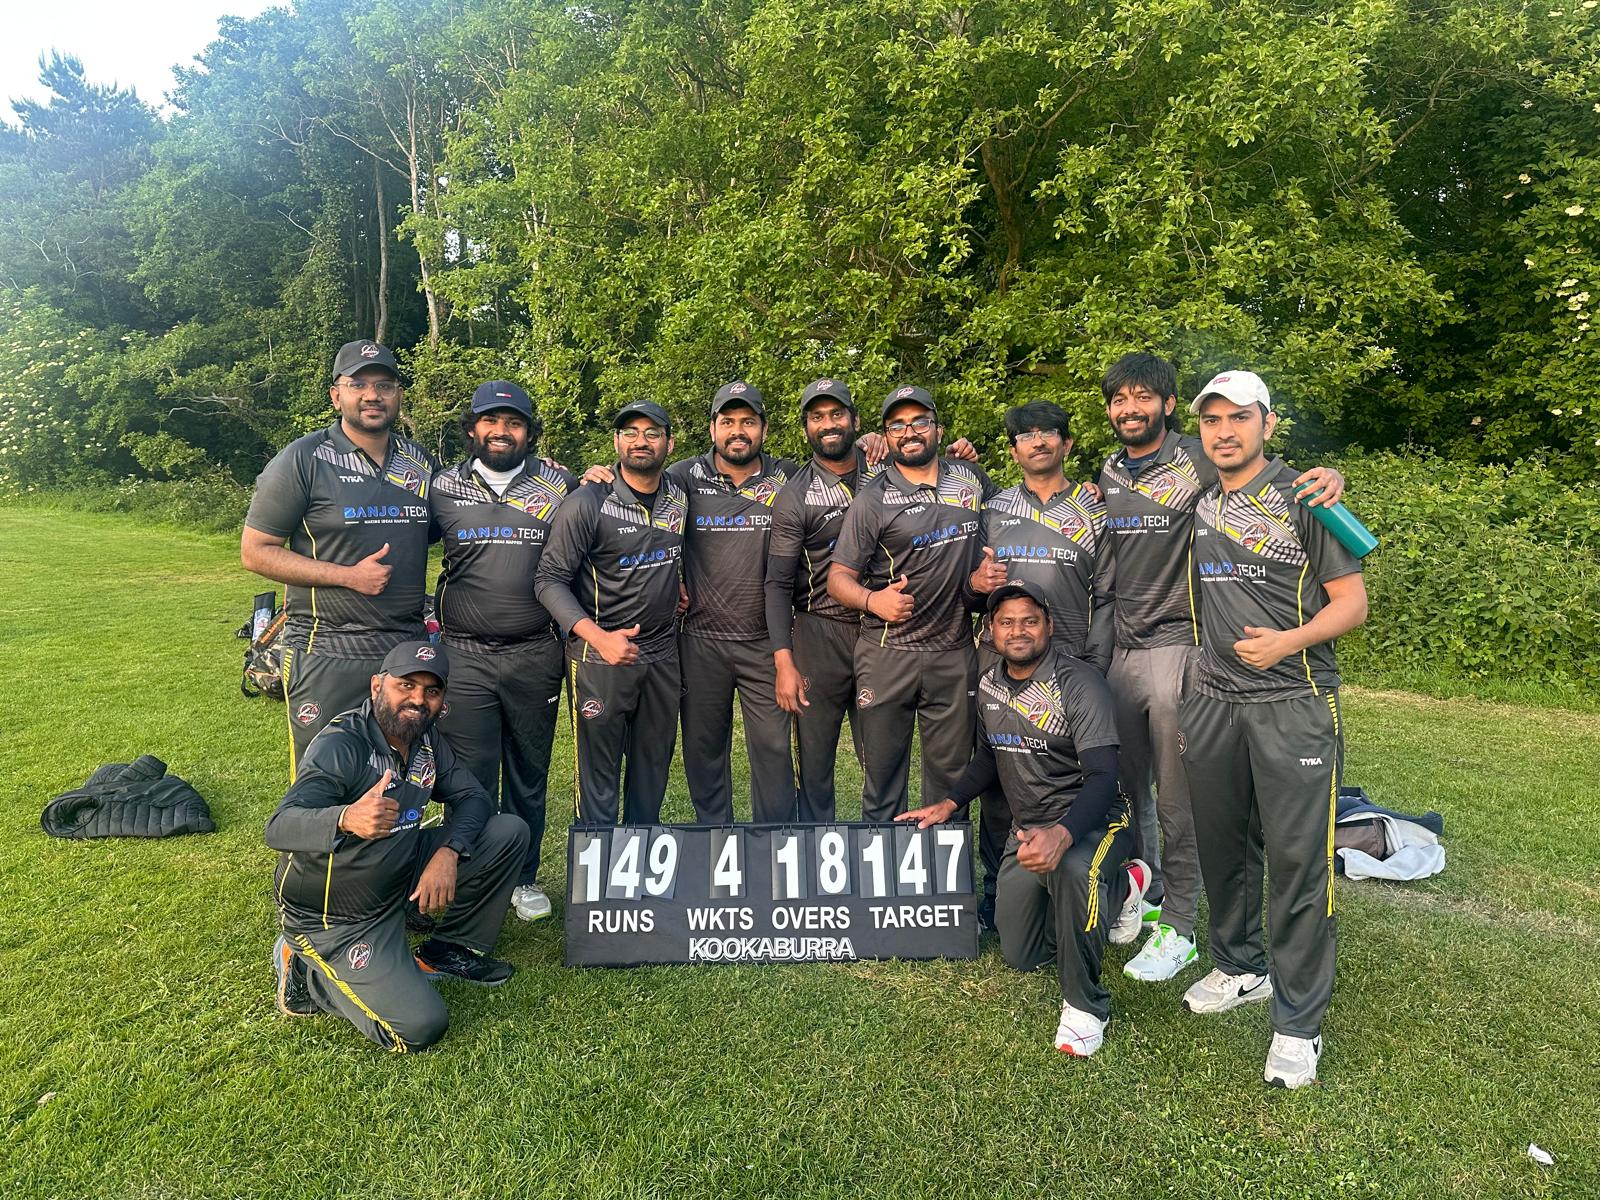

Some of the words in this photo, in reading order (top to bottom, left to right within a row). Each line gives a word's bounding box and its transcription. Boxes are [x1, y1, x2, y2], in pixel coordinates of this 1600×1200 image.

[339, 475, 364, 483] TYKA
[343, 505, 428, 519] BANJO.TECH
[823, 509, 843, 521] TYKA
[905, 505, 926, 515] TYKA
[1000, 518, 1021, 526] TYKA
[457, 526, 544, 540] BANJO.TECH
[617, 526, 638, 535] TYKA
[997, 545, 1078, 562] BANJO.TECH
[1299, 757, 1323, 766] TYKA
[578, 833, 678, 902] 149
[713, 834, 743, 897] 4
[862, 829, 965, 898] 147
[587, 909, 655, 933] RUNS
[686, 907, 754, 931] WKTS
[771, 906, 851, 930] OVERS
[869, 904, 964, 929] TARGET
[688, 937, 856, 961] KOOKABURRA
